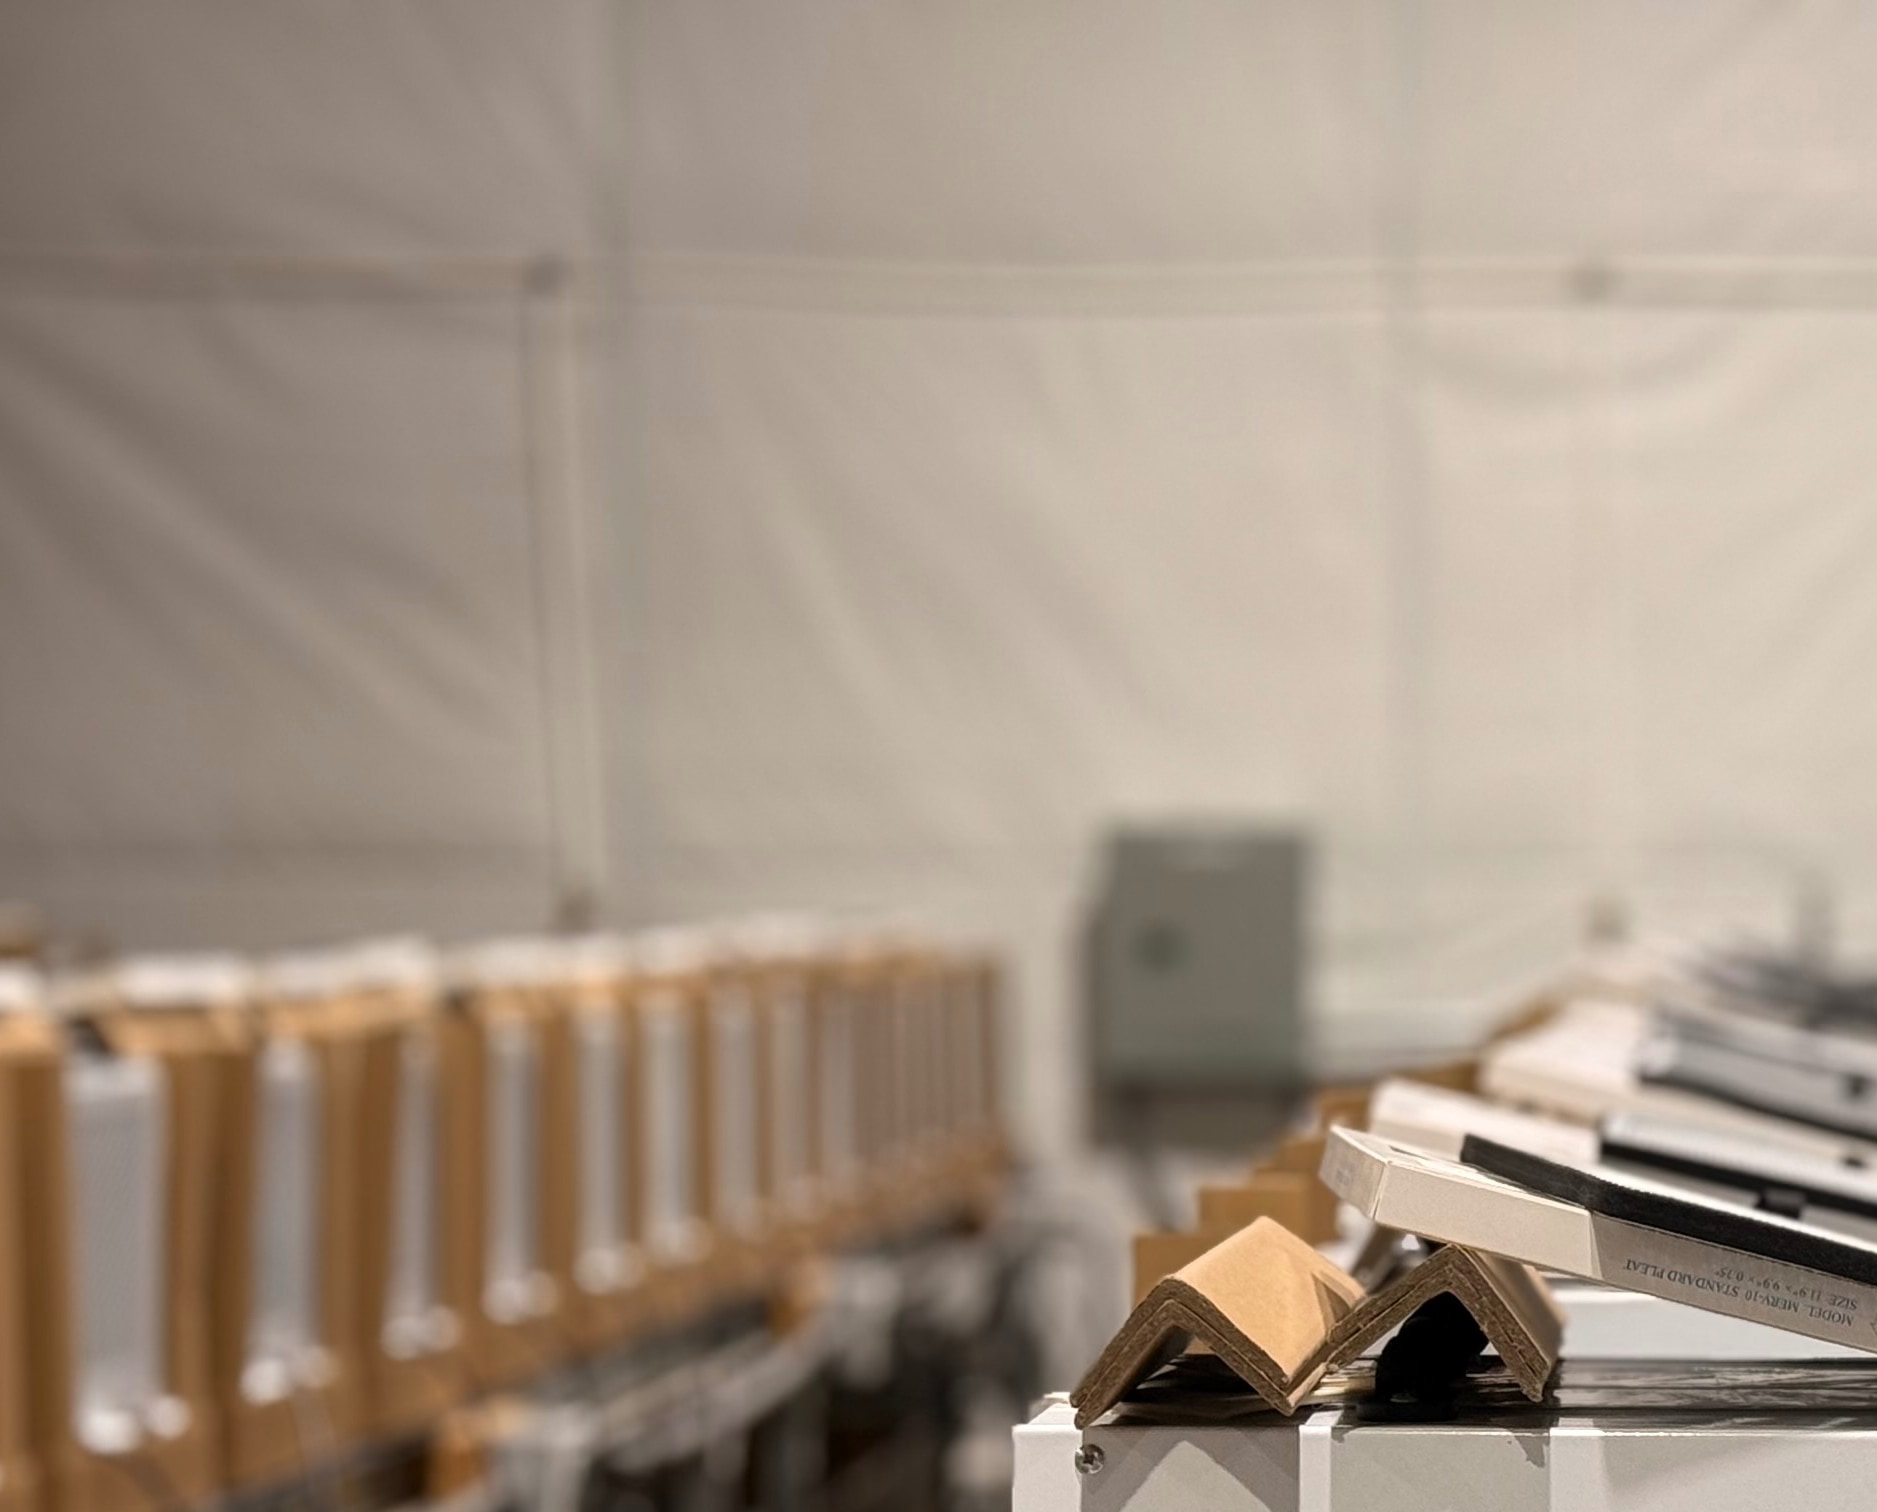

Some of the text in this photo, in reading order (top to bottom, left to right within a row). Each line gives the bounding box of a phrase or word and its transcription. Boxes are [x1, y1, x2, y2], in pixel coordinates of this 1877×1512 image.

[1625, 1258, 1665, 1279] PLEAT
[1667, 1270, 1740, 1298] STANDARD
[1744, 1289, 1800, 1313] MERV-10
